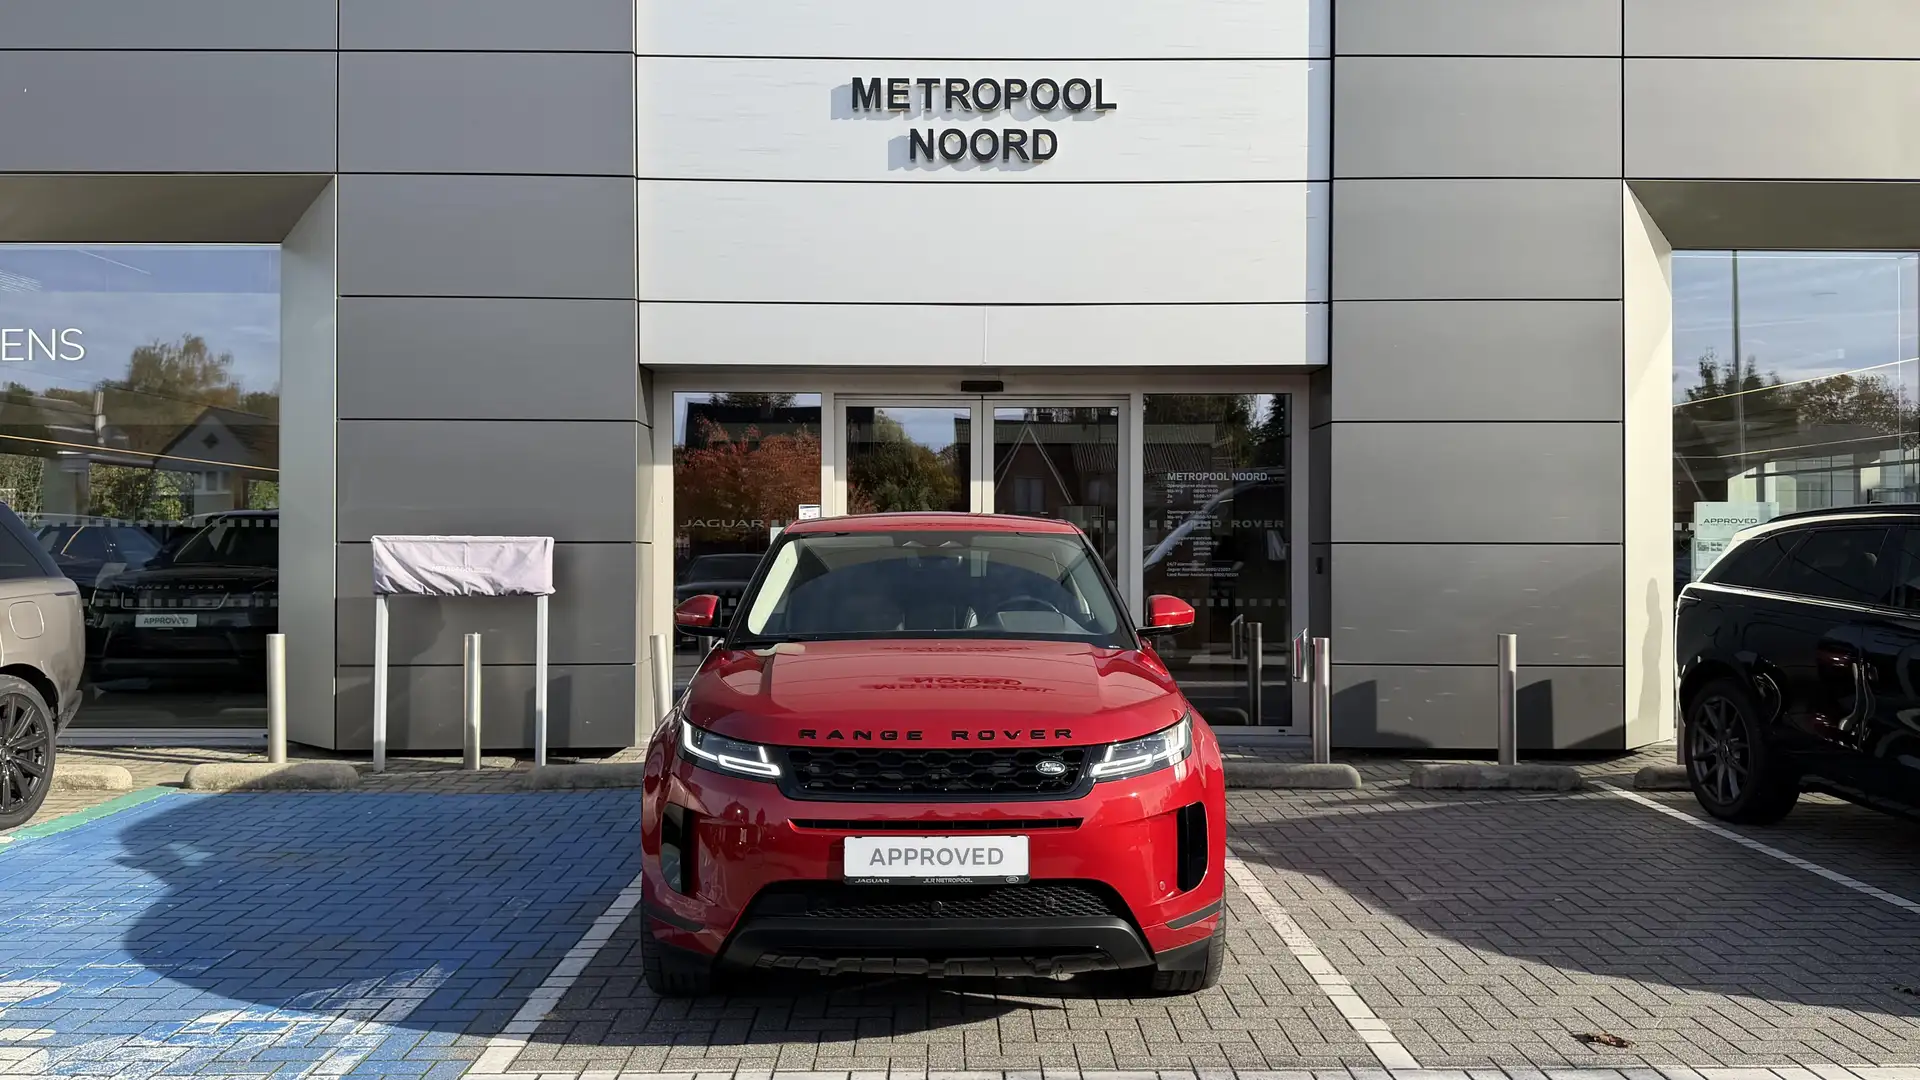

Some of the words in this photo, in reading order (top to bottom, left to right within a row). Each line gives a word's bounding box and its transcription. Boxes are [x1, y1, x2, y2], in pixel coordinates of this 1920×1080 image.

[851, 77, 1118, 111] METROPOOL
[909, 128, 1058, 162] NOORD
[0, 327, 86, 362] ENS
[1167, 472, 1230, 481] METROPOOL
[1231, 472, 1268, 481] NOORD
[680, 518, 765, 529] JAGUAR
[1231, 519, 1285, 528] ROVER
[143, 617, 189, 625] APPROVED
[798, 729, 923, 741] RANGE
[951, 728, 1073, 741] ROVER
[869, 847, 1004, 866] APPROVED
